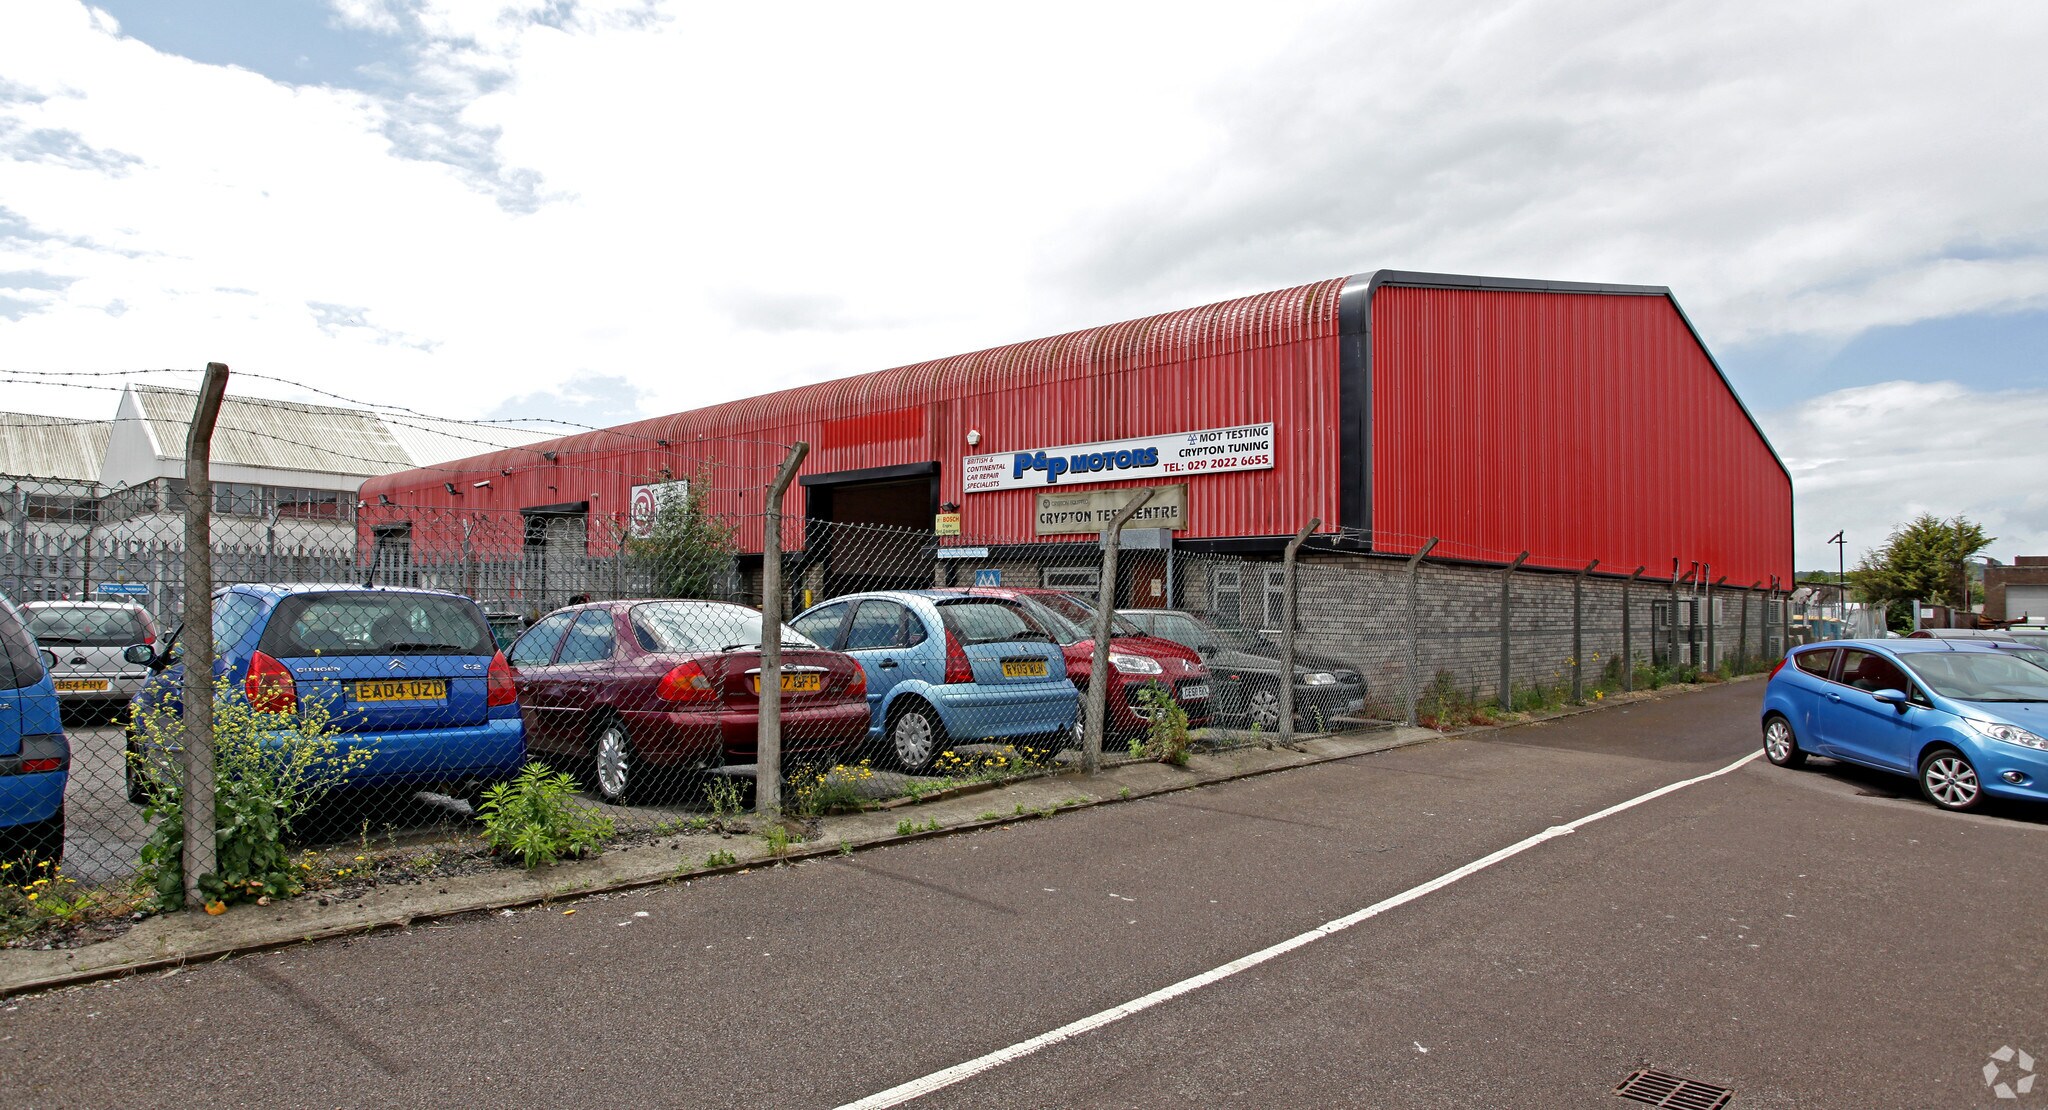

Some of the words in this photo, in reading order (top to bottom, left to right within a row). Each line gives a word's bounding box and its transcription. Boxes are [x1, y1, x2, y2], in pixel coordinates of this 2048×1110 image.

[1199, 432, 1223, 443] MOT
[1225, 426, 1269, 440] TESTING
[1178, 445, 1225, 458] CRYPTON
[1227, 440, 1269, 453] TUNING
[966, 463, 1006, 473] CONTINENTAL
[967, 457, 989, 465] BRITISH
[1069, 447, 1159, 474] MOTORS
[1163, 462, 1184, 473] TEL:
[1187, 460, 1207, 471] 029
[1210, 457, 1237, 469] 2022
[1240, 454, 1269, 466] 6655
[979, 472, 1000, 480] REPAIR
[966, 480, 1000, 489] SPECIALISTS
[1040, 510, 1092, 525] CRYPTON
[360, 682, 405, 699] EA04
